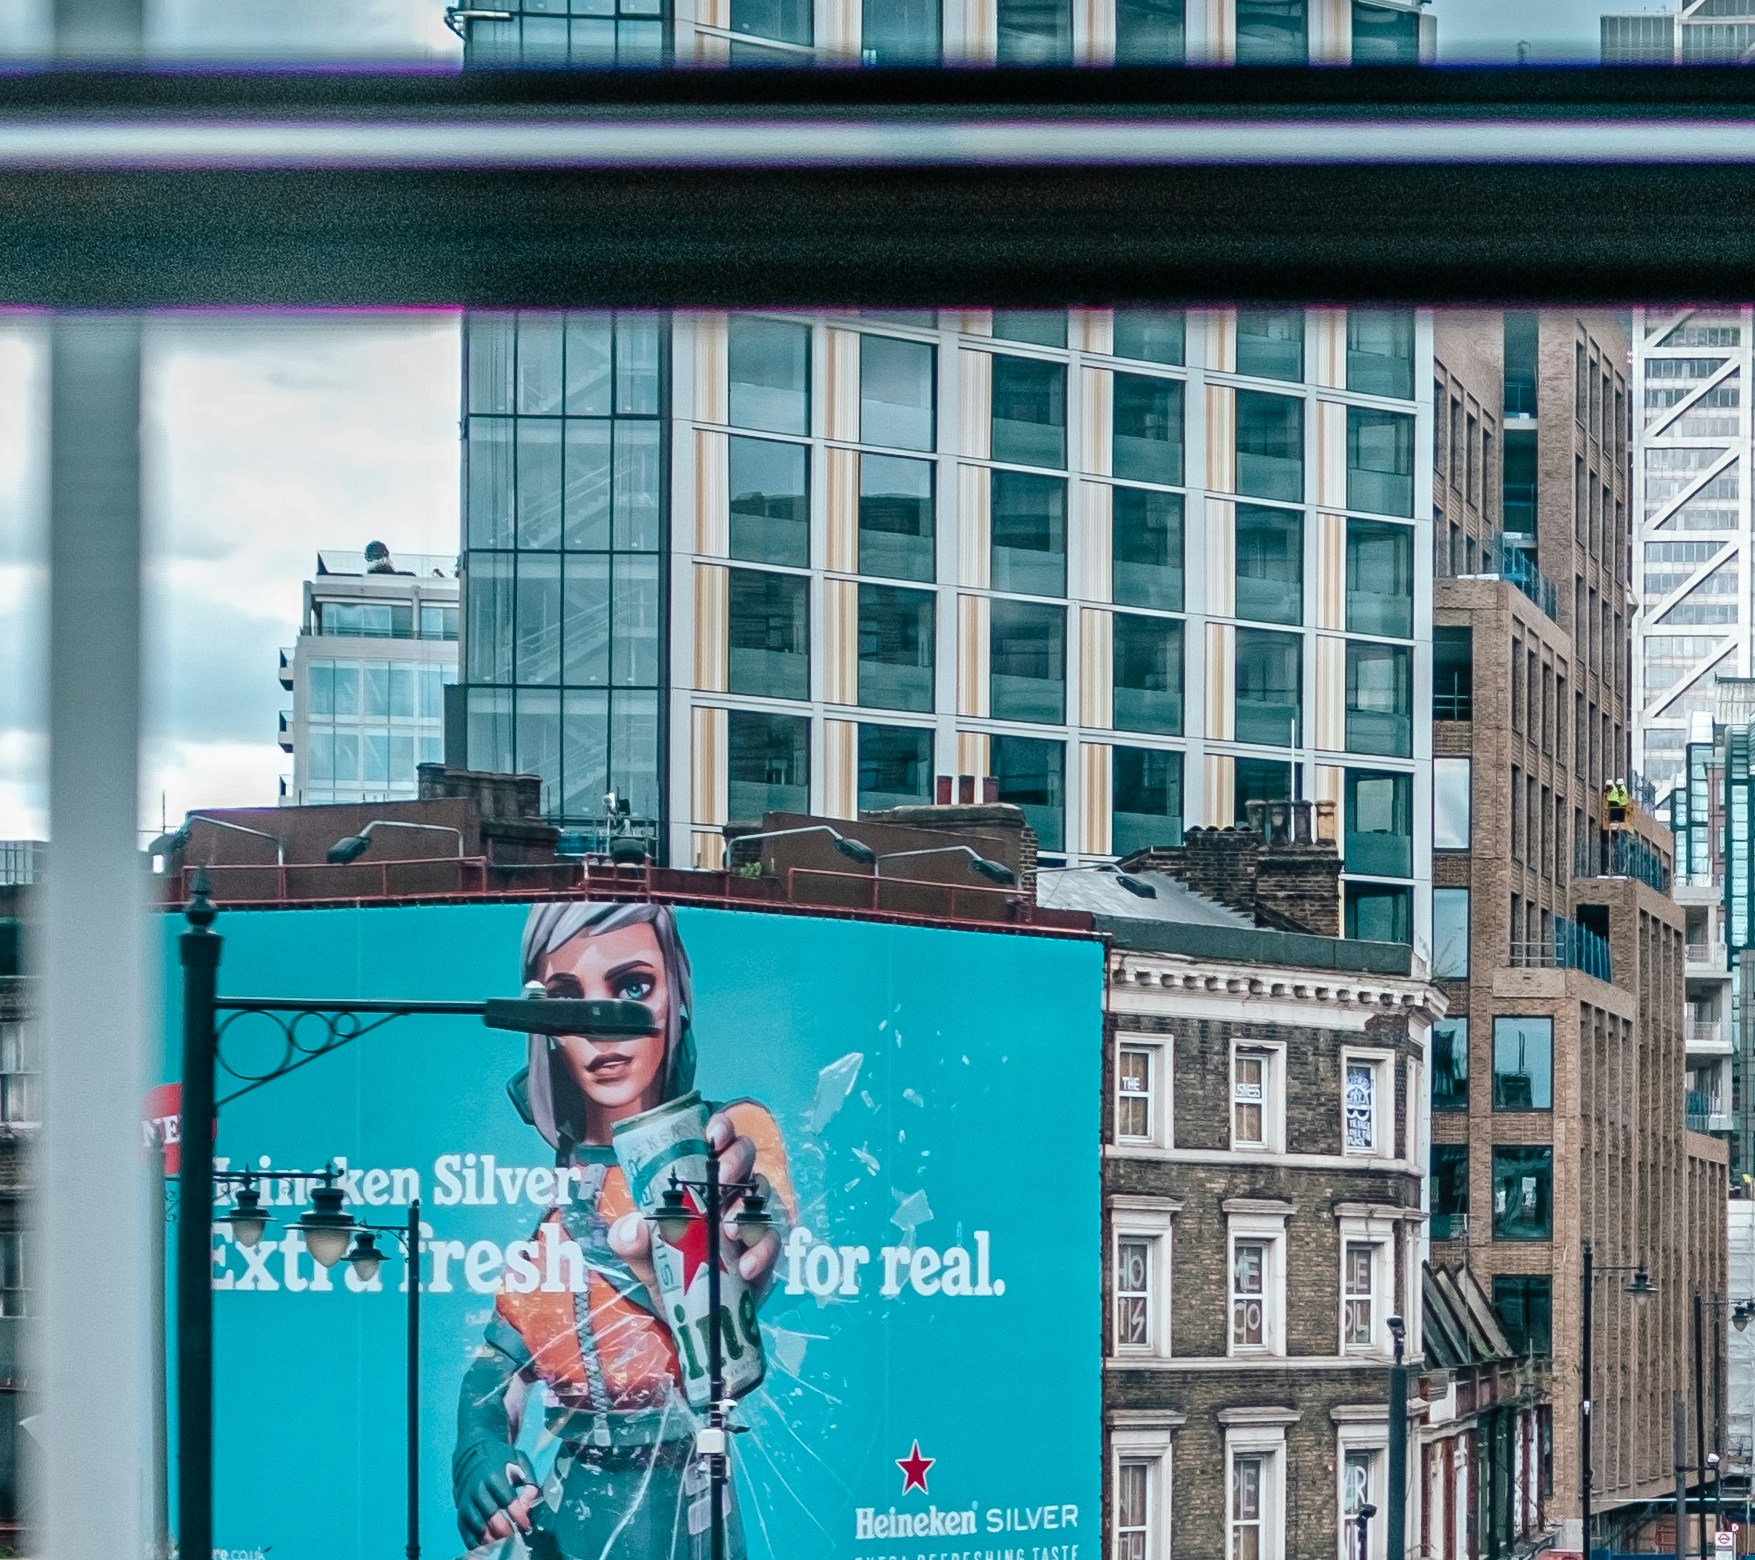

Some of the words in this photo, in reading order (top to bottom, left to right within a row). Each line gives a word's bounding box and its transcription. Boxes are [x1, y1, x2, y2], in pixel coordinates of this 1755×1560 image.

[141, 1114, 181, 1147] NE
[434, 1153, 584, 1206] Silver
[398, 1220, 589, 1295] fresh
[784, 1226, 870, 1297] for
[880, 1229, 1007, 1297] real.
[855, 1504, 977, 1539] Heineken
[986, 1504, 1079, 1533] SILVER
